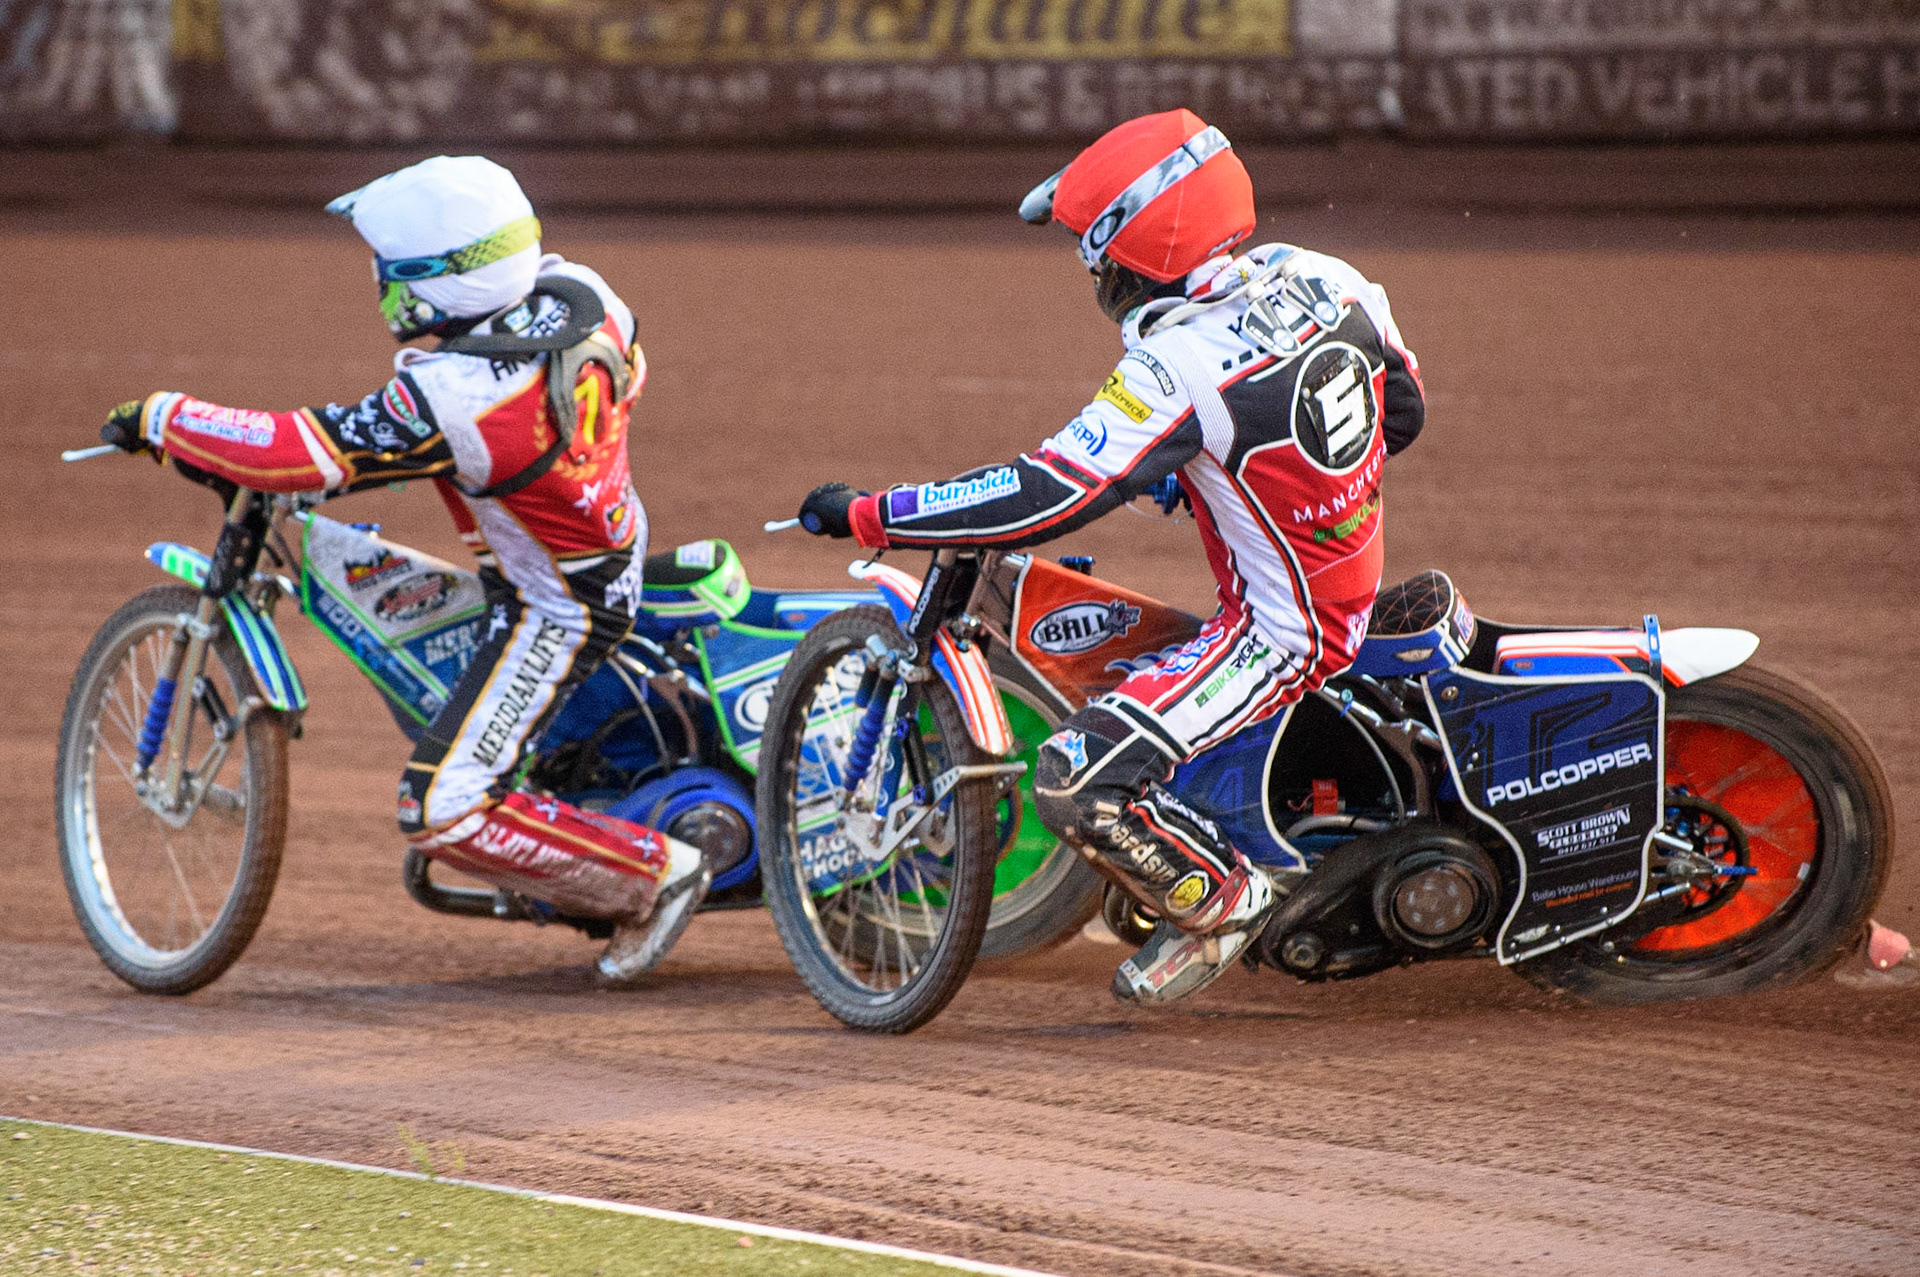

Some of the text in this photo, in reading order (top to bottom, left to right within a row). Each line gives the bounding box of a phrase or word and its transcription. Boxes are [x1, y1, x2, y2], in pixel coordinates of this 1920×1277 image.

[1315, 363, 1366, 458] 5
[472, 667, 540, 768] MERIDIAN
[1486, 742, 1653, 807] POLCOPPER
[1537, 823, 1577, 848] SCOTT
[1580, 807, 1631, 832] BROWN
